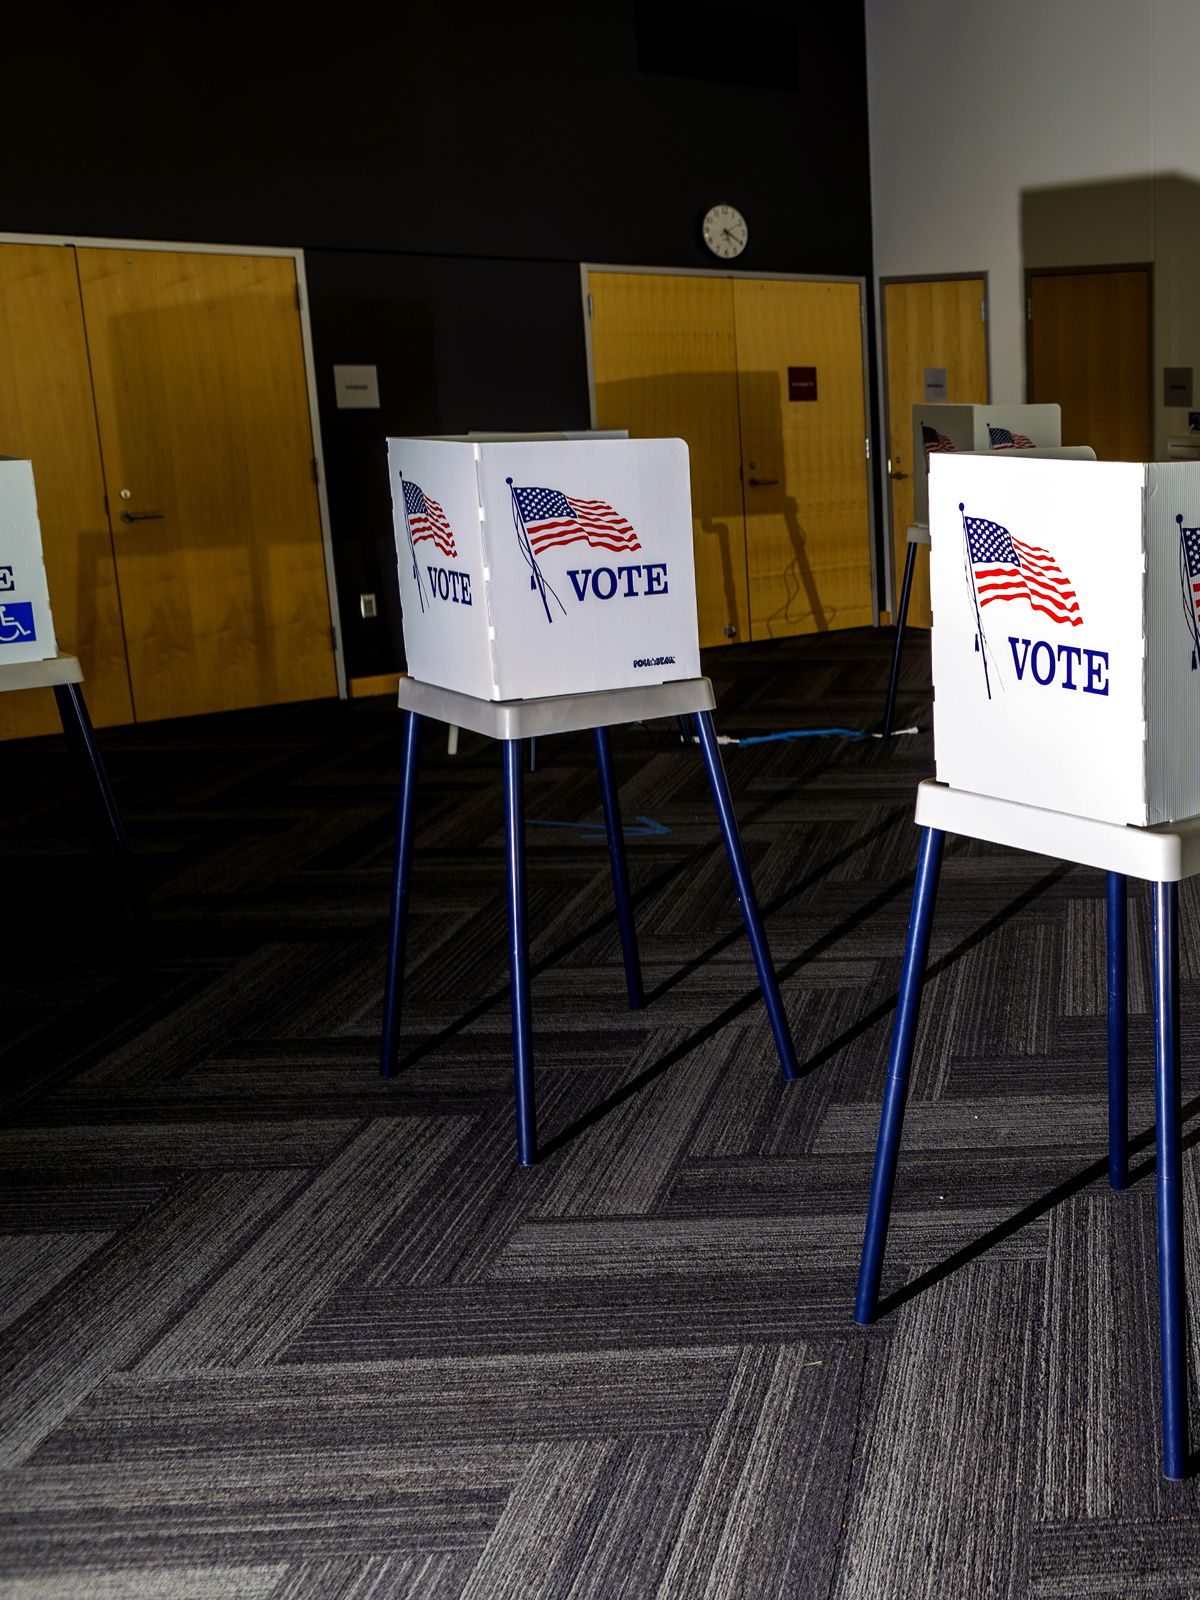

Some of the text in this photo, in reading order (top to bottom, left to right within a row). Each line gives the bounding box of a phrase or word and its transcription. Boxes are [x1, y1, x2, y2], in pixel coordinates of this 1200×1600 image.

[427, 566, 473, 606] VOTE
[567, 563, 669, 602] VOTE
[1008, 636, 1110, 696] VOTE
